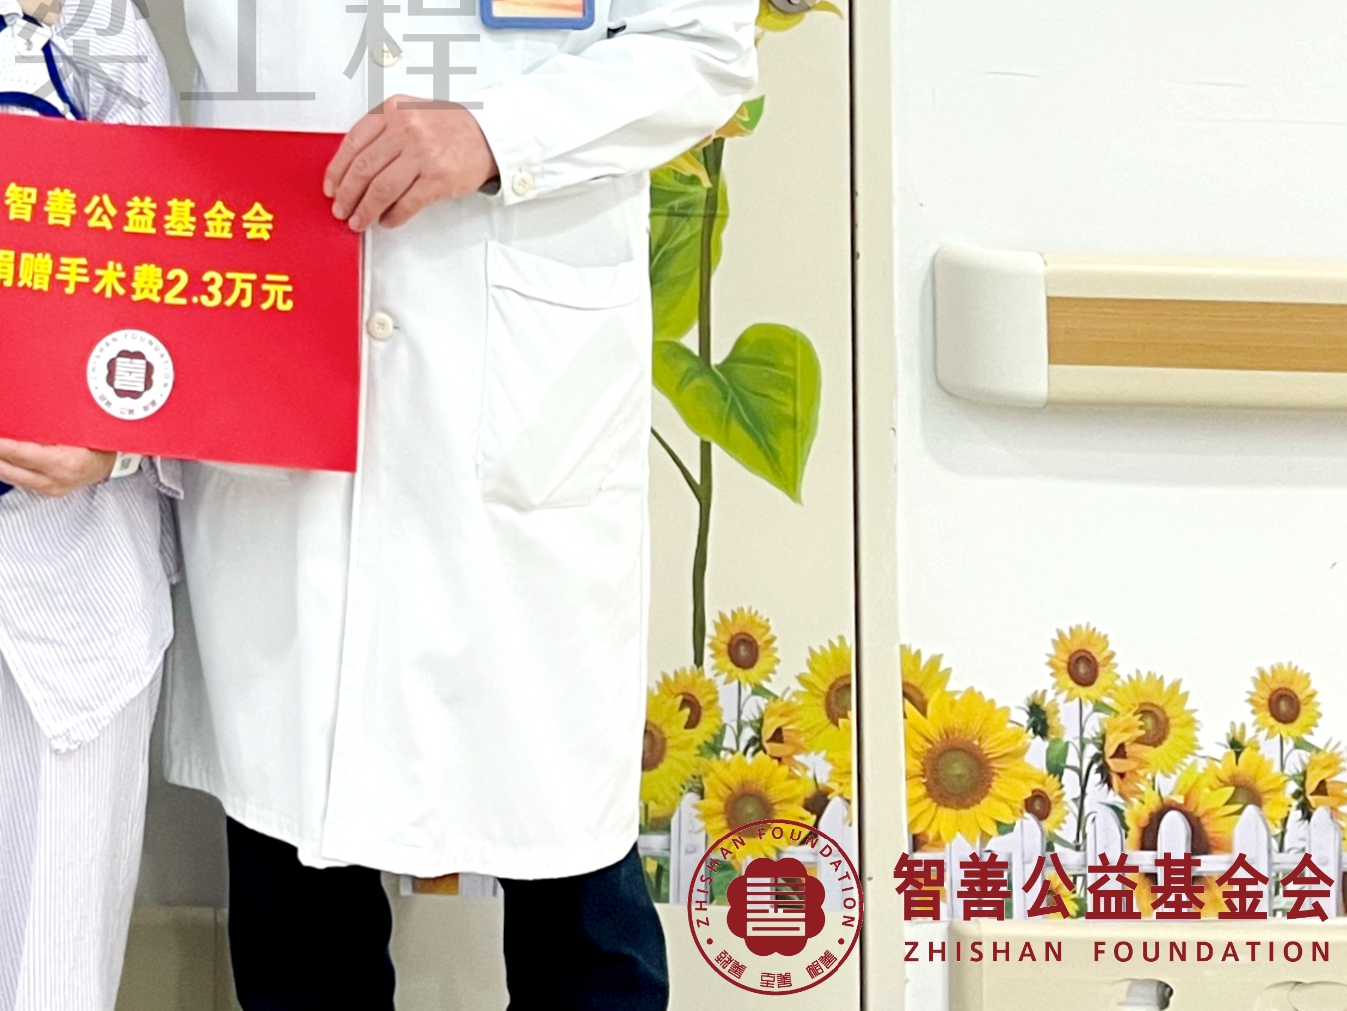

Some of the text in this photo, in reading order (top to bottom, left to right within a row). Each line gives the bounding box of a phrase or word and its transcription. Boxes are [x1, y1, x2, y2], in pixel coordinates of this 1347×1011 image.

[4, 182, 274, 241] 智善公益基金会
